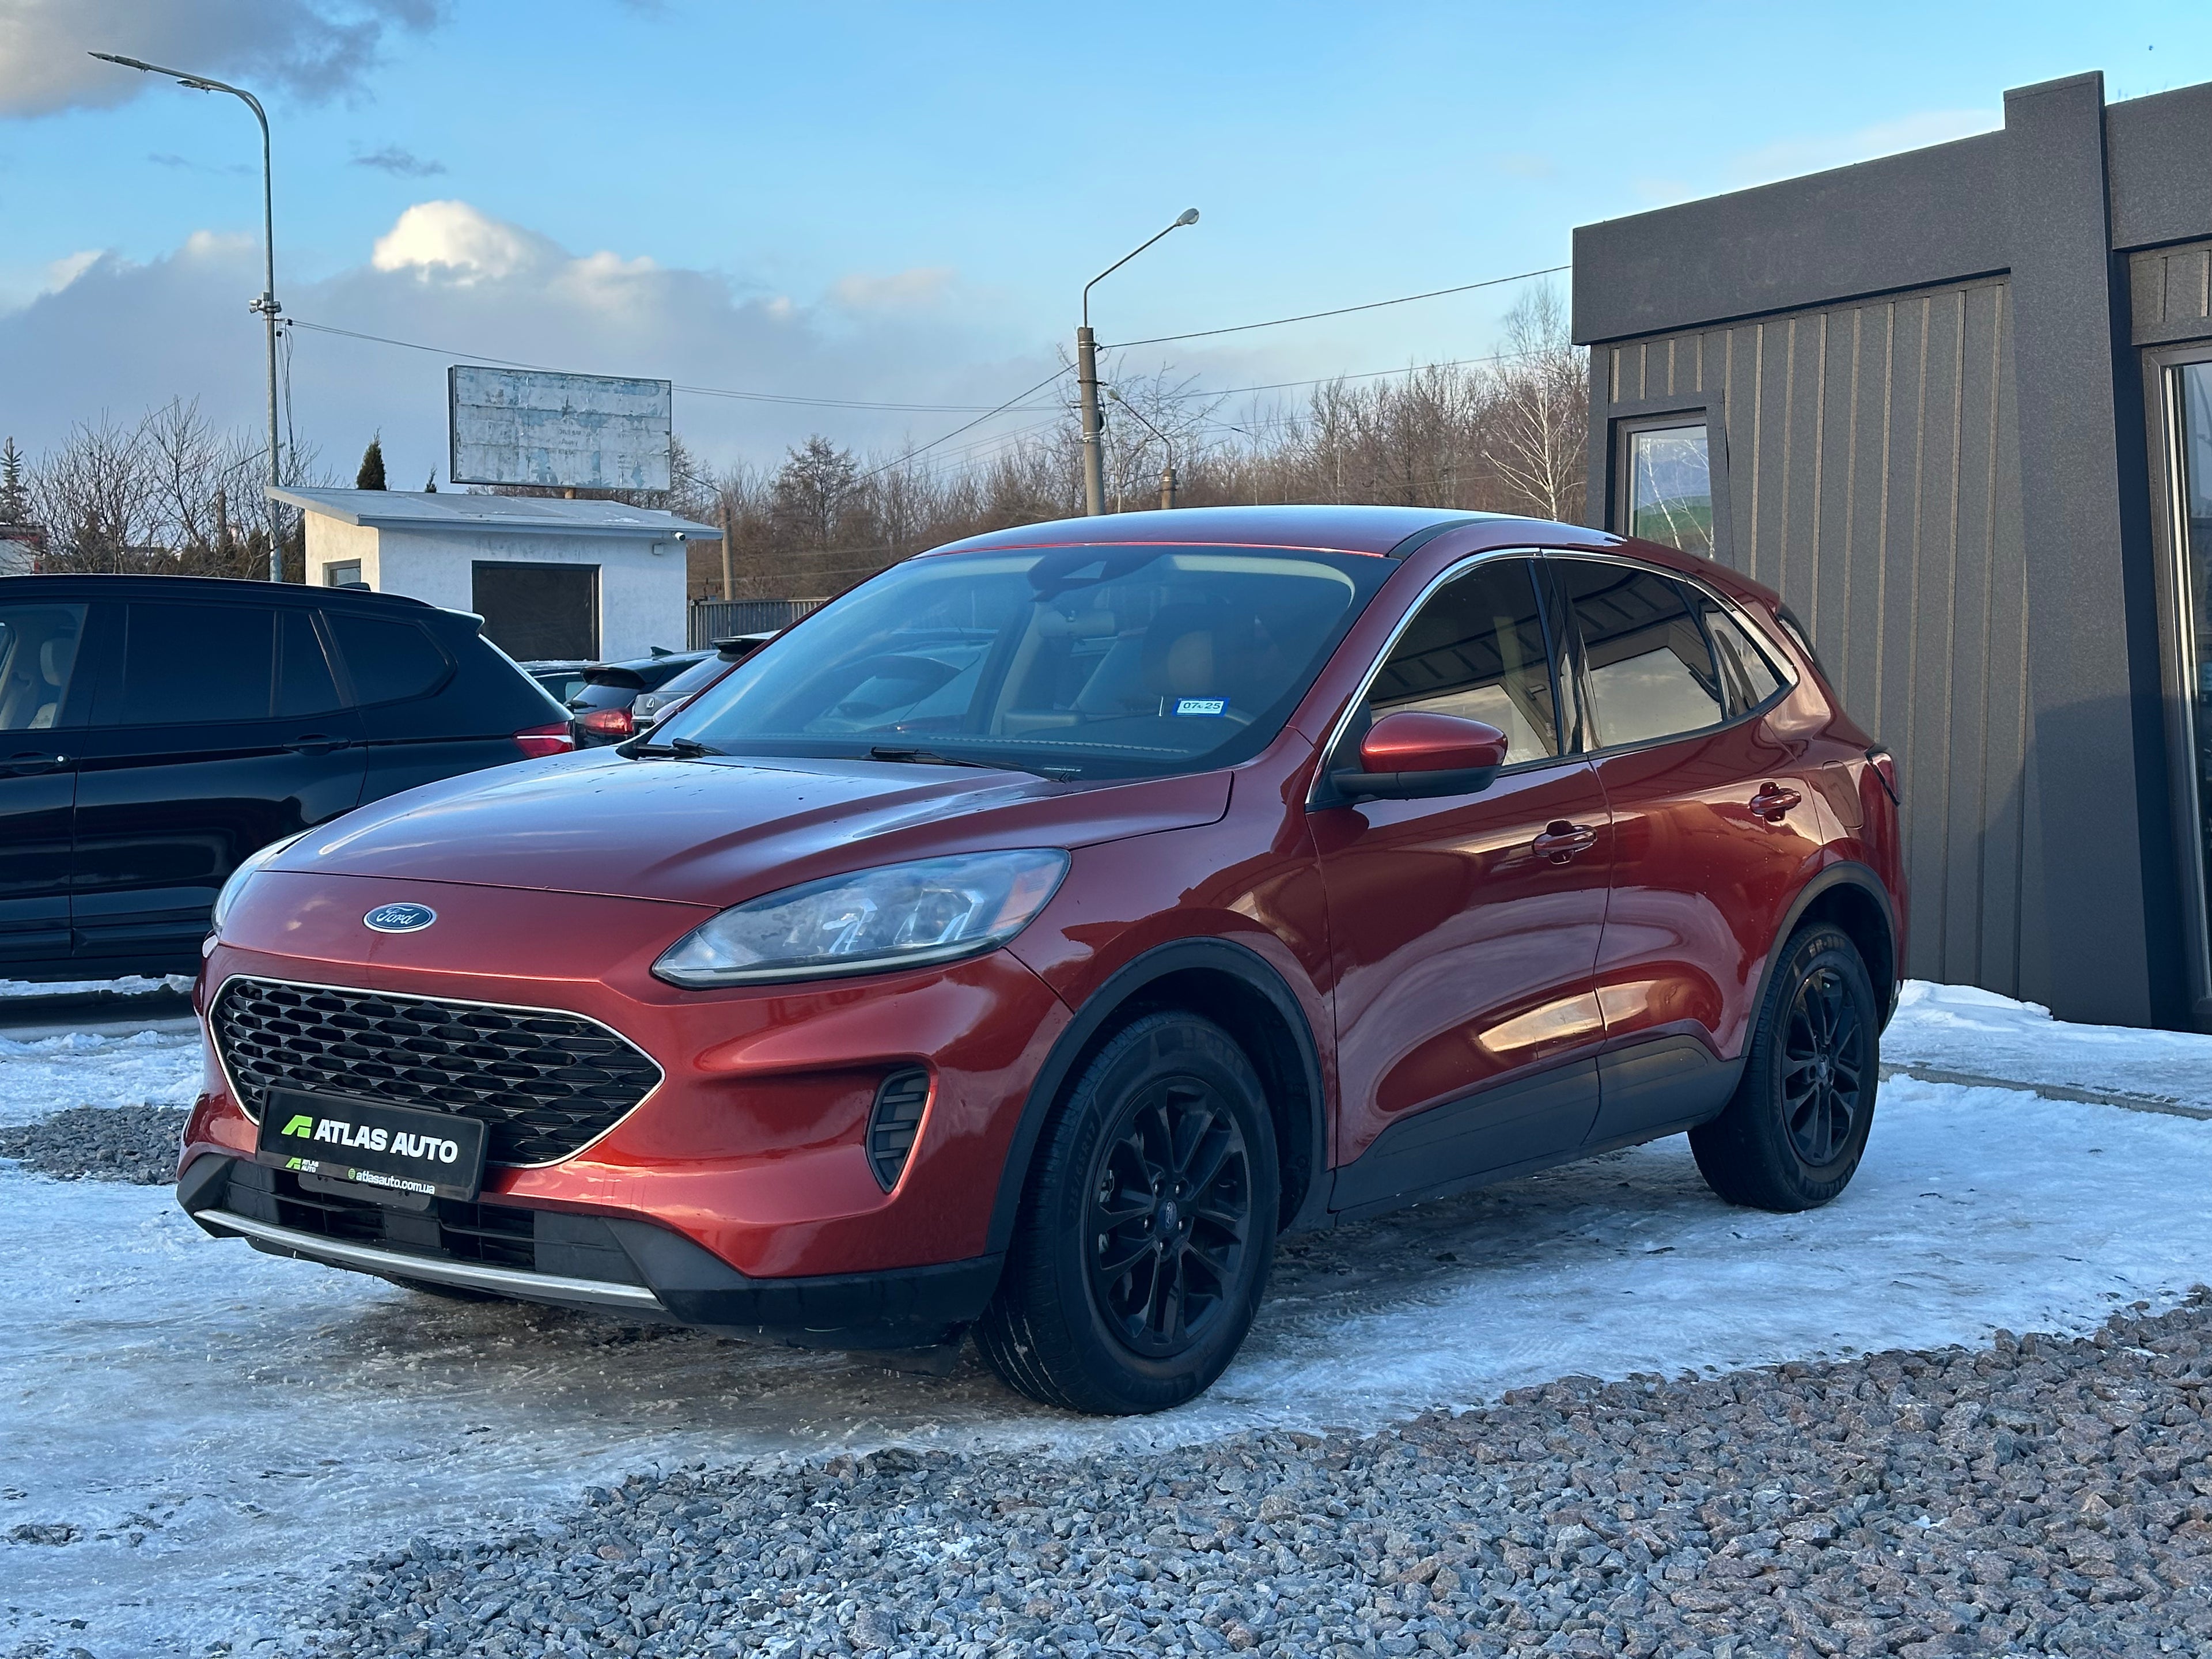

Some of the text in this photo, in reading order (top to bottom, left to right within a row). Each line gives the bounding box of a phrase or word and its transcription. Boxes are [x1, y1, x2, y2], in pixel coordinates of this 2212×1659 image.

[376, 906, 420, 925] Ford
[313, 1118, 459, 1164] ATLAS AUTO
[301, 1165, 316, 1173] AUTO
[302, 1159, 319, 1168] ATLAS
[355, 1170, 435, 1195] atlasauto.com.ua
